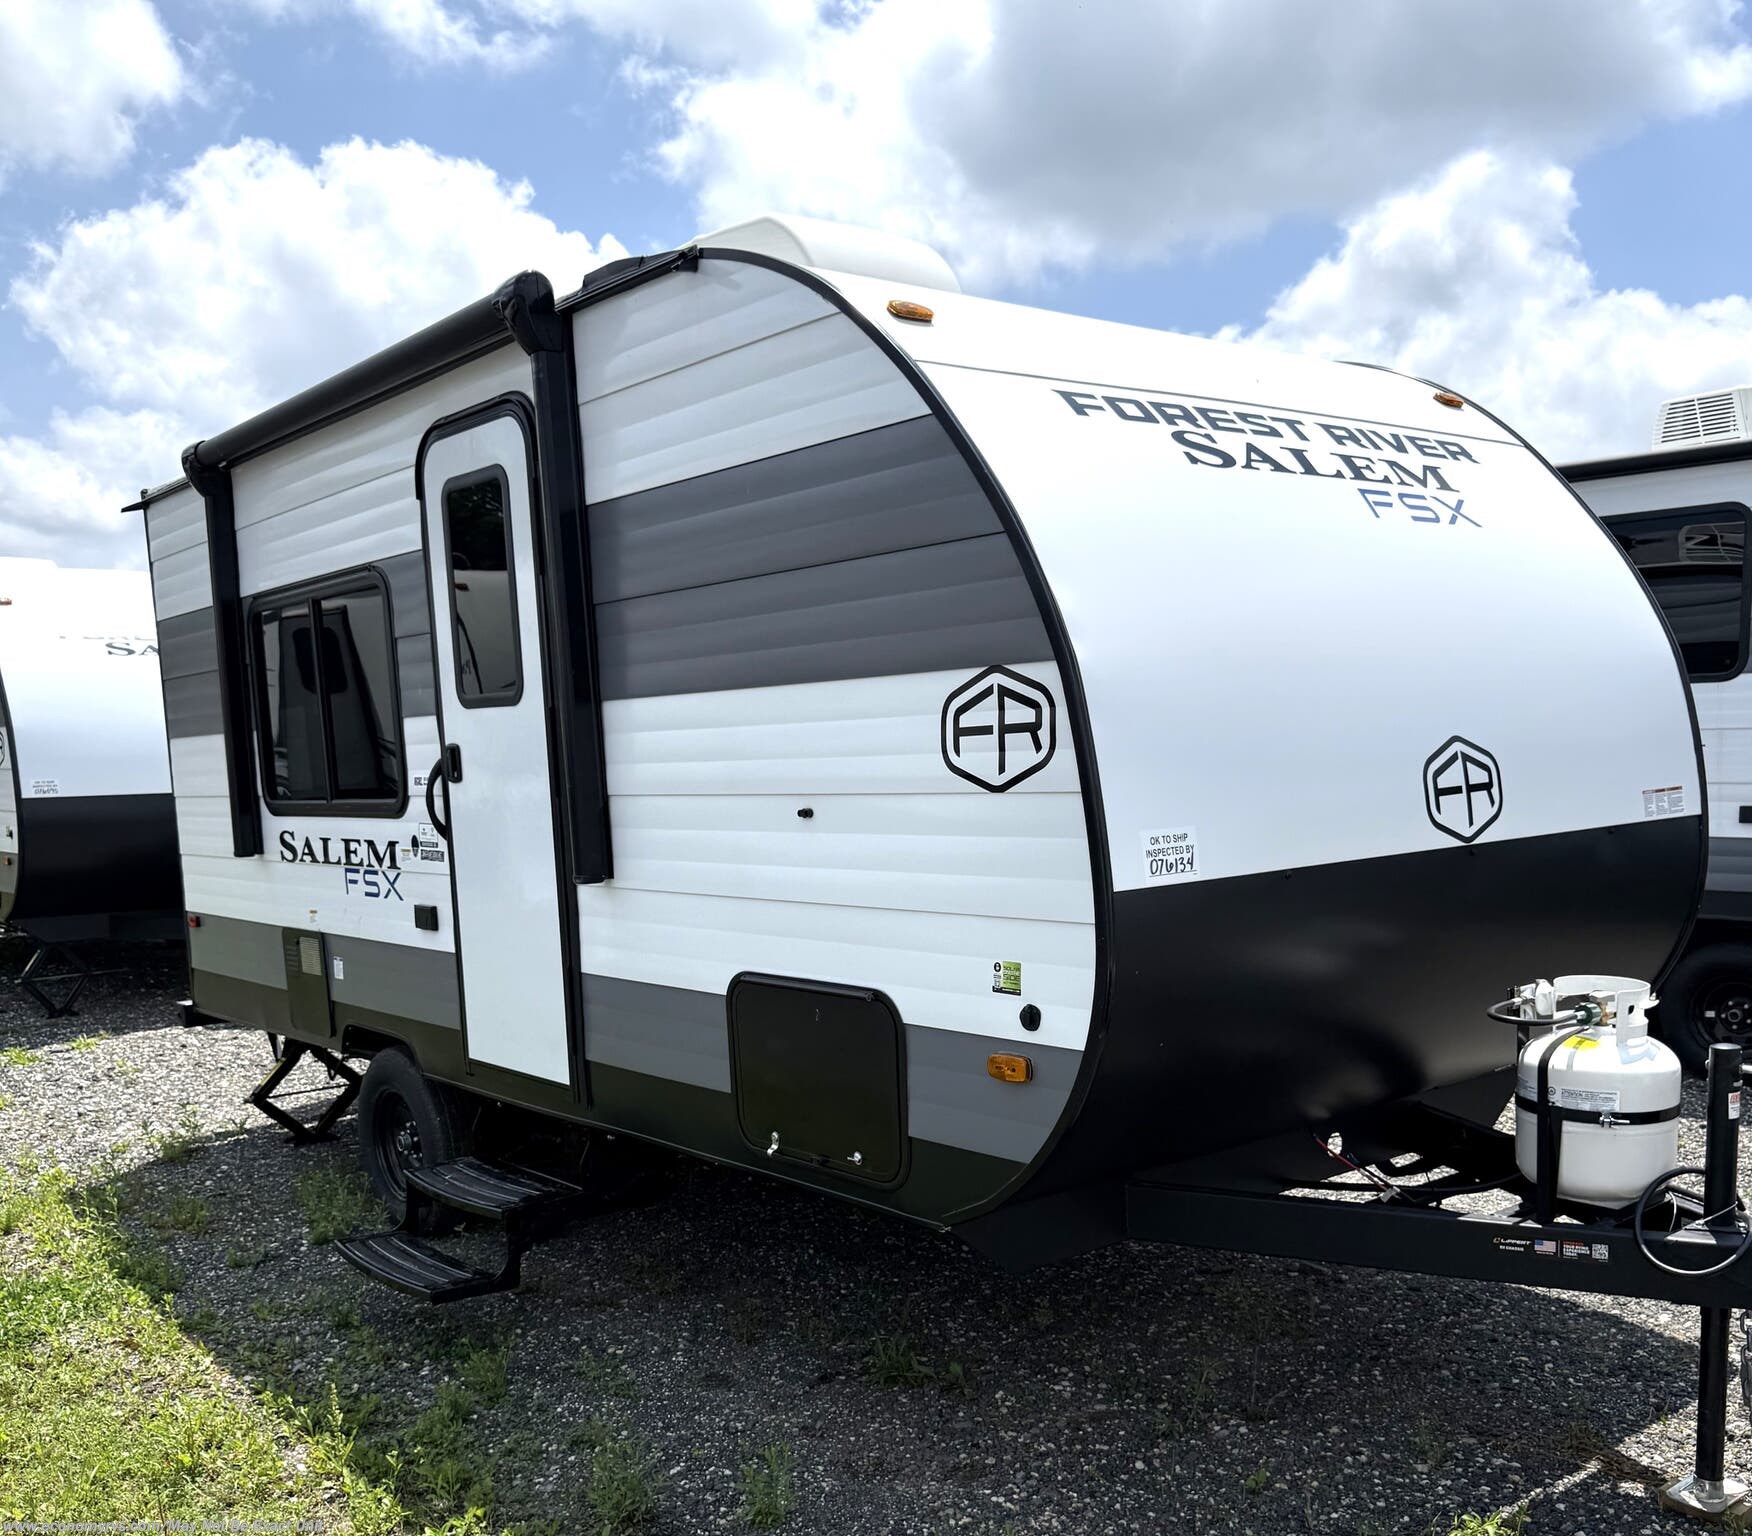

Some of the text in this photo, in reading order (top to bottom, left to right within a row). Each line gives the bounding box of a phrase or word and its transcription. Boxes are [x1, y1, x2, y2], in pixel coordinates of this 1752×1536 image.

[1051, 389, 1480, 464] FOREST RIVER
[1170, 429, 1460, 493] SALEM
[1357, 487, 1483, 528] FSX
[279, 830, 402, 870] SALEM
[1146, 844, 1195, 859] INSPECTED BY
[1150, 833, 1188, 845] OK TO SHIP
[1150, 853, 1194, 875] 076134
[344, 867, 404, 902] FSX
